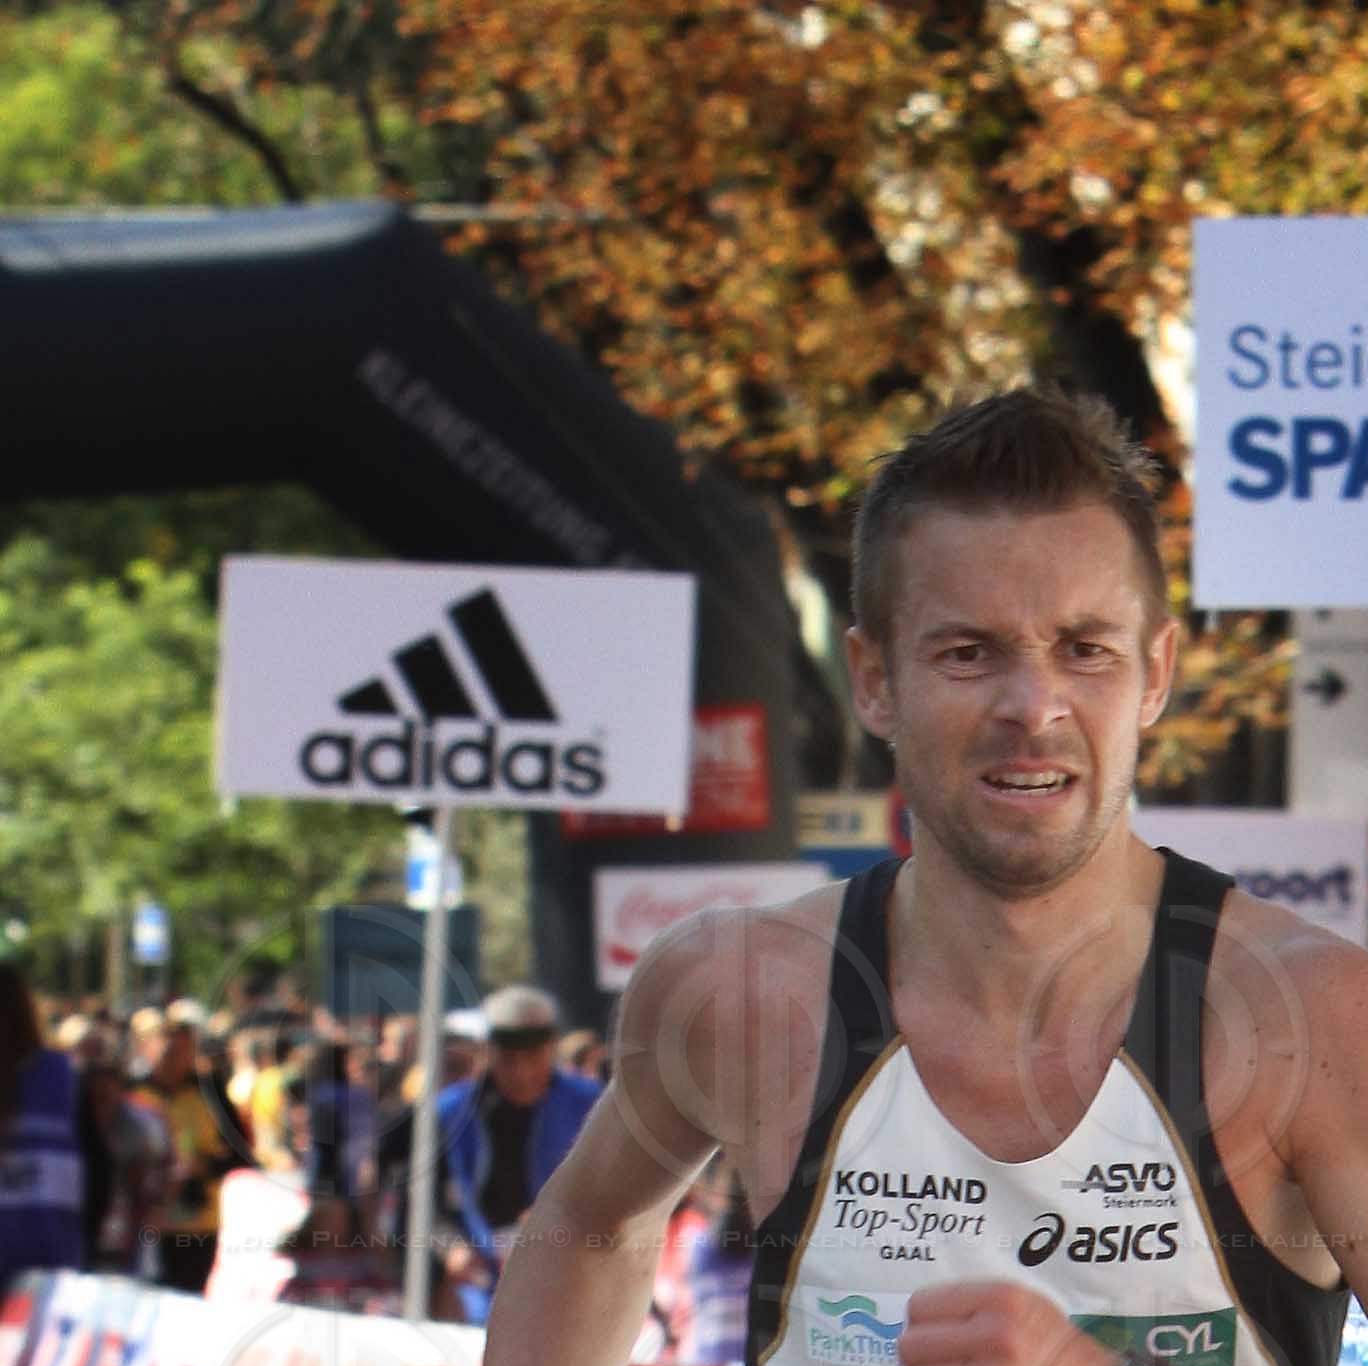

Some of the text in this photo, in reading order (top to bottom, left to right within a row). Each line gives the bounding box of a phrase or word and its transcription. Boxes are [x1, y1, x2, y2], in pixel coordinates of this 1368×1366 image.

[300, 719, 607, 797] adidas
[835, 1170, 989, 1205] KOLLAND
[834, 1199, 986, 1240] Top-Sport
[880, 1245, 936, 1261] GAAL
[1067, 1222, 1180, 1264] asics
